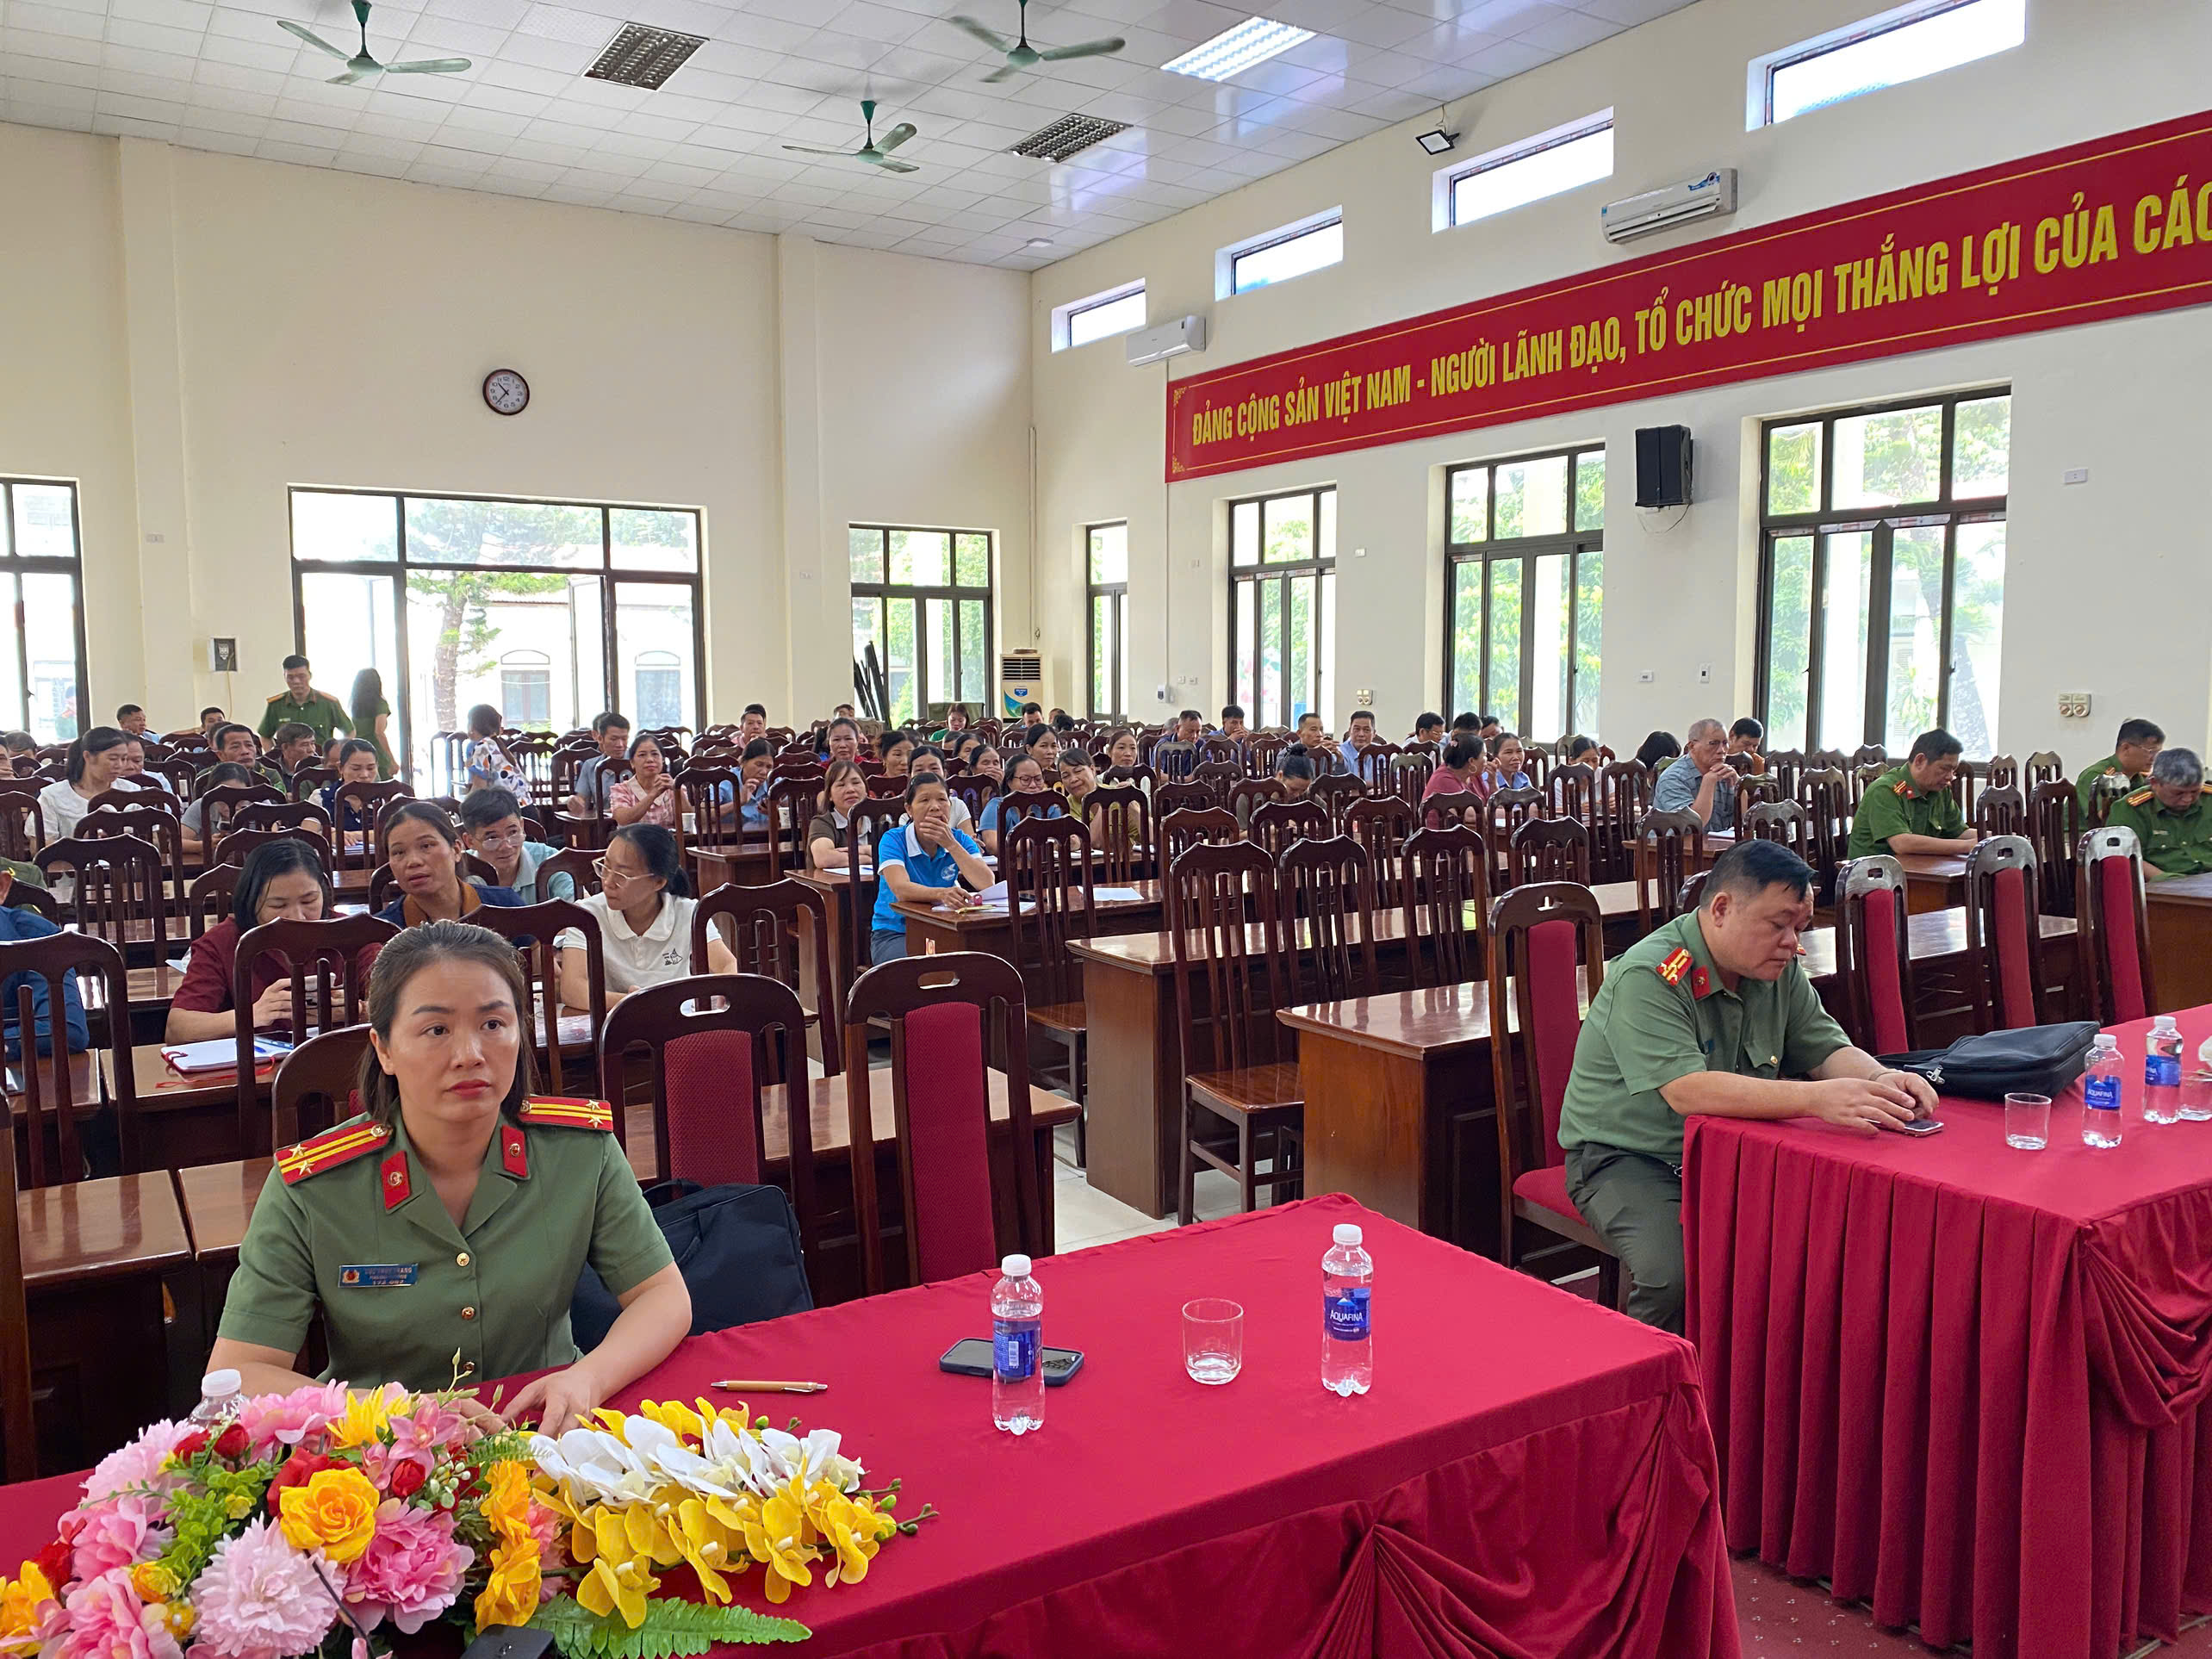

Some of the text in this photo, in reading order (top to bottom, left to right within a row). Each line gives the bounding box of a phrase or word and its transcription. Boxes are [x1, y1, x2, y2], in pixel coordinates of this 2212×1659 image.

[1192, 399, 1233, 446] ĐẢNG
[1237, 392, 1280, 443] CỘNG
[1284, 376, 1320, 427] SẢN
[1324, 370, 1362, 424] VIỆT
[1366, 364, 1411, 410] NAM
[1431, 337, 1496, 397] NGƯỜI
[1502, 329, 1563, 383] LÃNH
[1569, 316, 1626, 374] ĐẠO,
[1634, 287, 1668, 355] TỔ
[1675, 280, 1752, 345] CHỨC
[1762, 268, 1823, 333] MỌI
[1833, 233, 1948, 314] THẮNG
[1960, 222, 2021, 297] LỢI
[2034, 192, 2118, 275] CỦA
[1329, 1309, 1364, 1322] AQUAFINA
